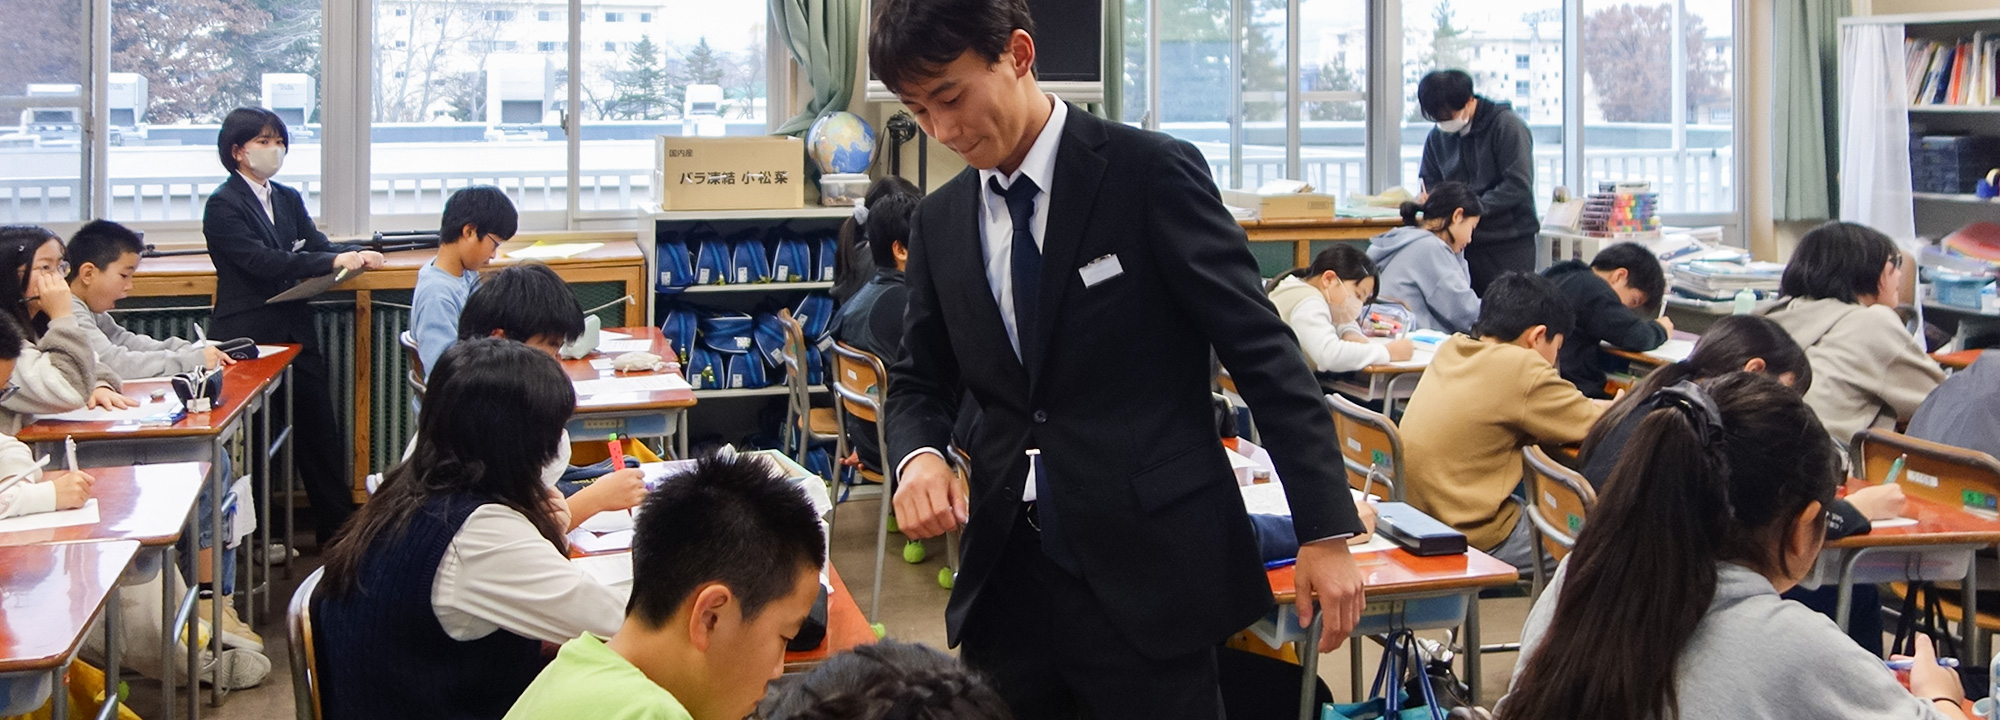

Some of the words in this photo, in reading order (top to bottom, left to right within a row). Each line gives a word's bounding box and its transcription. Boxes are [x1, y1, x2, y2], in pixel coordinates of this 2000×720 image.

[669, 149, 693, 157] 国内産
[680, 171, 735, 185] バラ凍結
[741, 171, 788, 185] 小松菜
